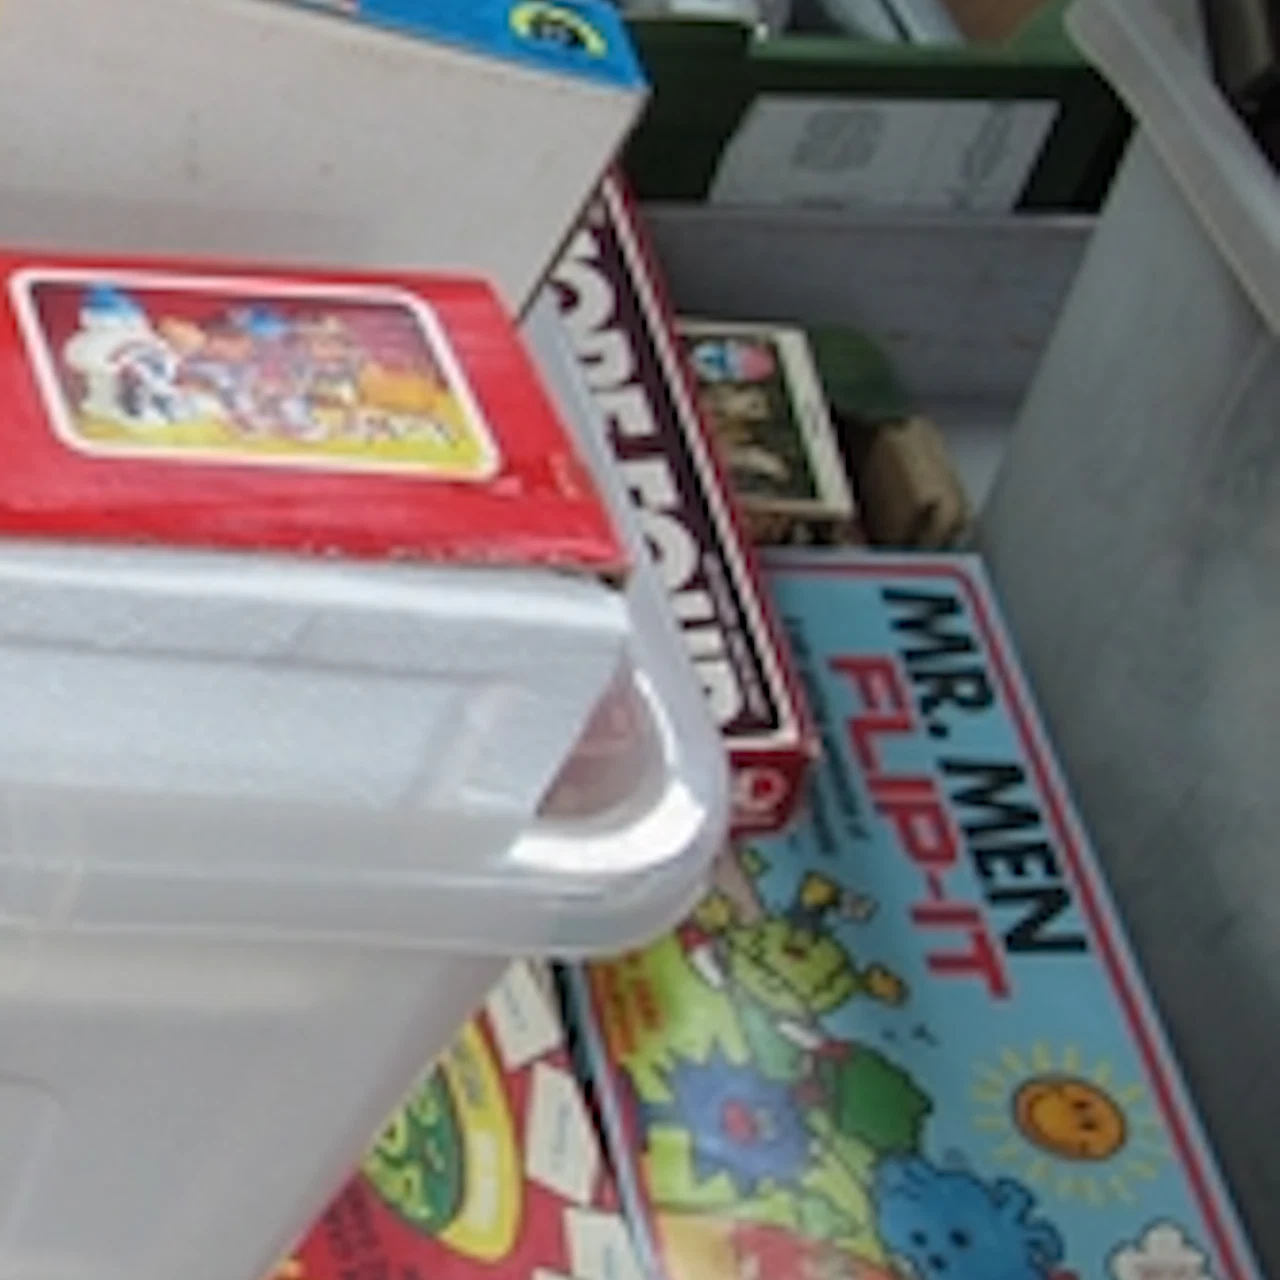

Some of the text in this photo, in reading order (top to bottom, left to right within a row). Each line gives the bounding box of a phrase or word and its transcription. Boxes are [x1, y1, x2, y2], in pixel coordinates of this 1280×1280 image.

[826, 654, 1012, 1000] FLIP-IT
[880, 586, 1090, 955] MR. MEN
